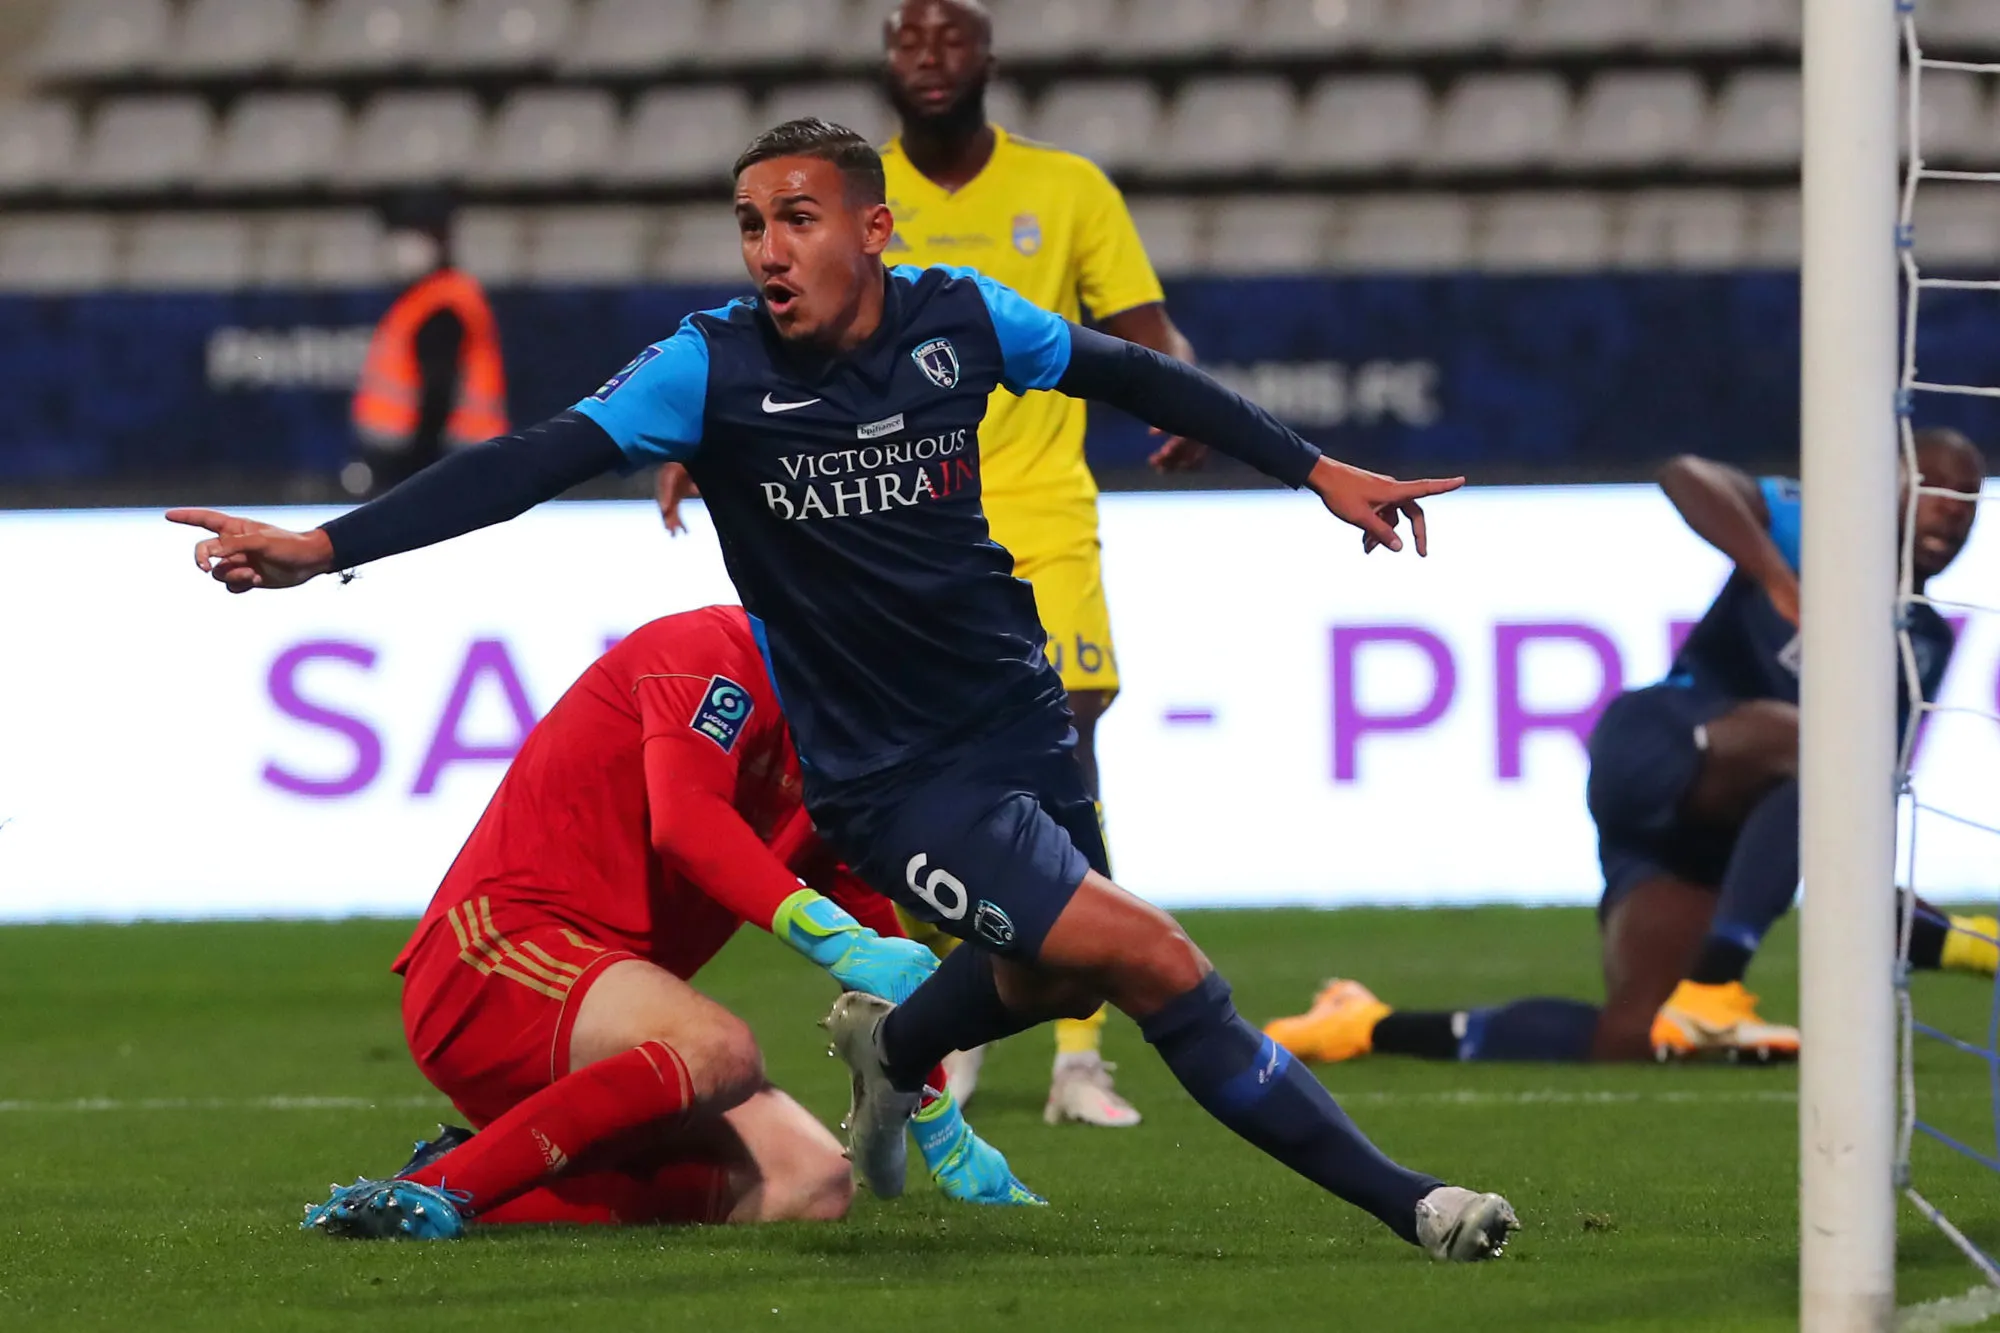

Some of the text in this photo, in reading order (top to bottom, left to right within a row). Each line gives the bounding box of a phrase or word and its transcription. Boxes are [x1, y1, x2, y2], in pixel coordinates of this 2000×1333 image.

[778, 429, 966, 480] VICTORIOUS
[760, 456, 974, 520] BAHRAIN
[261, 639, 624, 797] SA
[702, 712, 729, 731] LIGUE
[906, 852, 968, 921] 6
